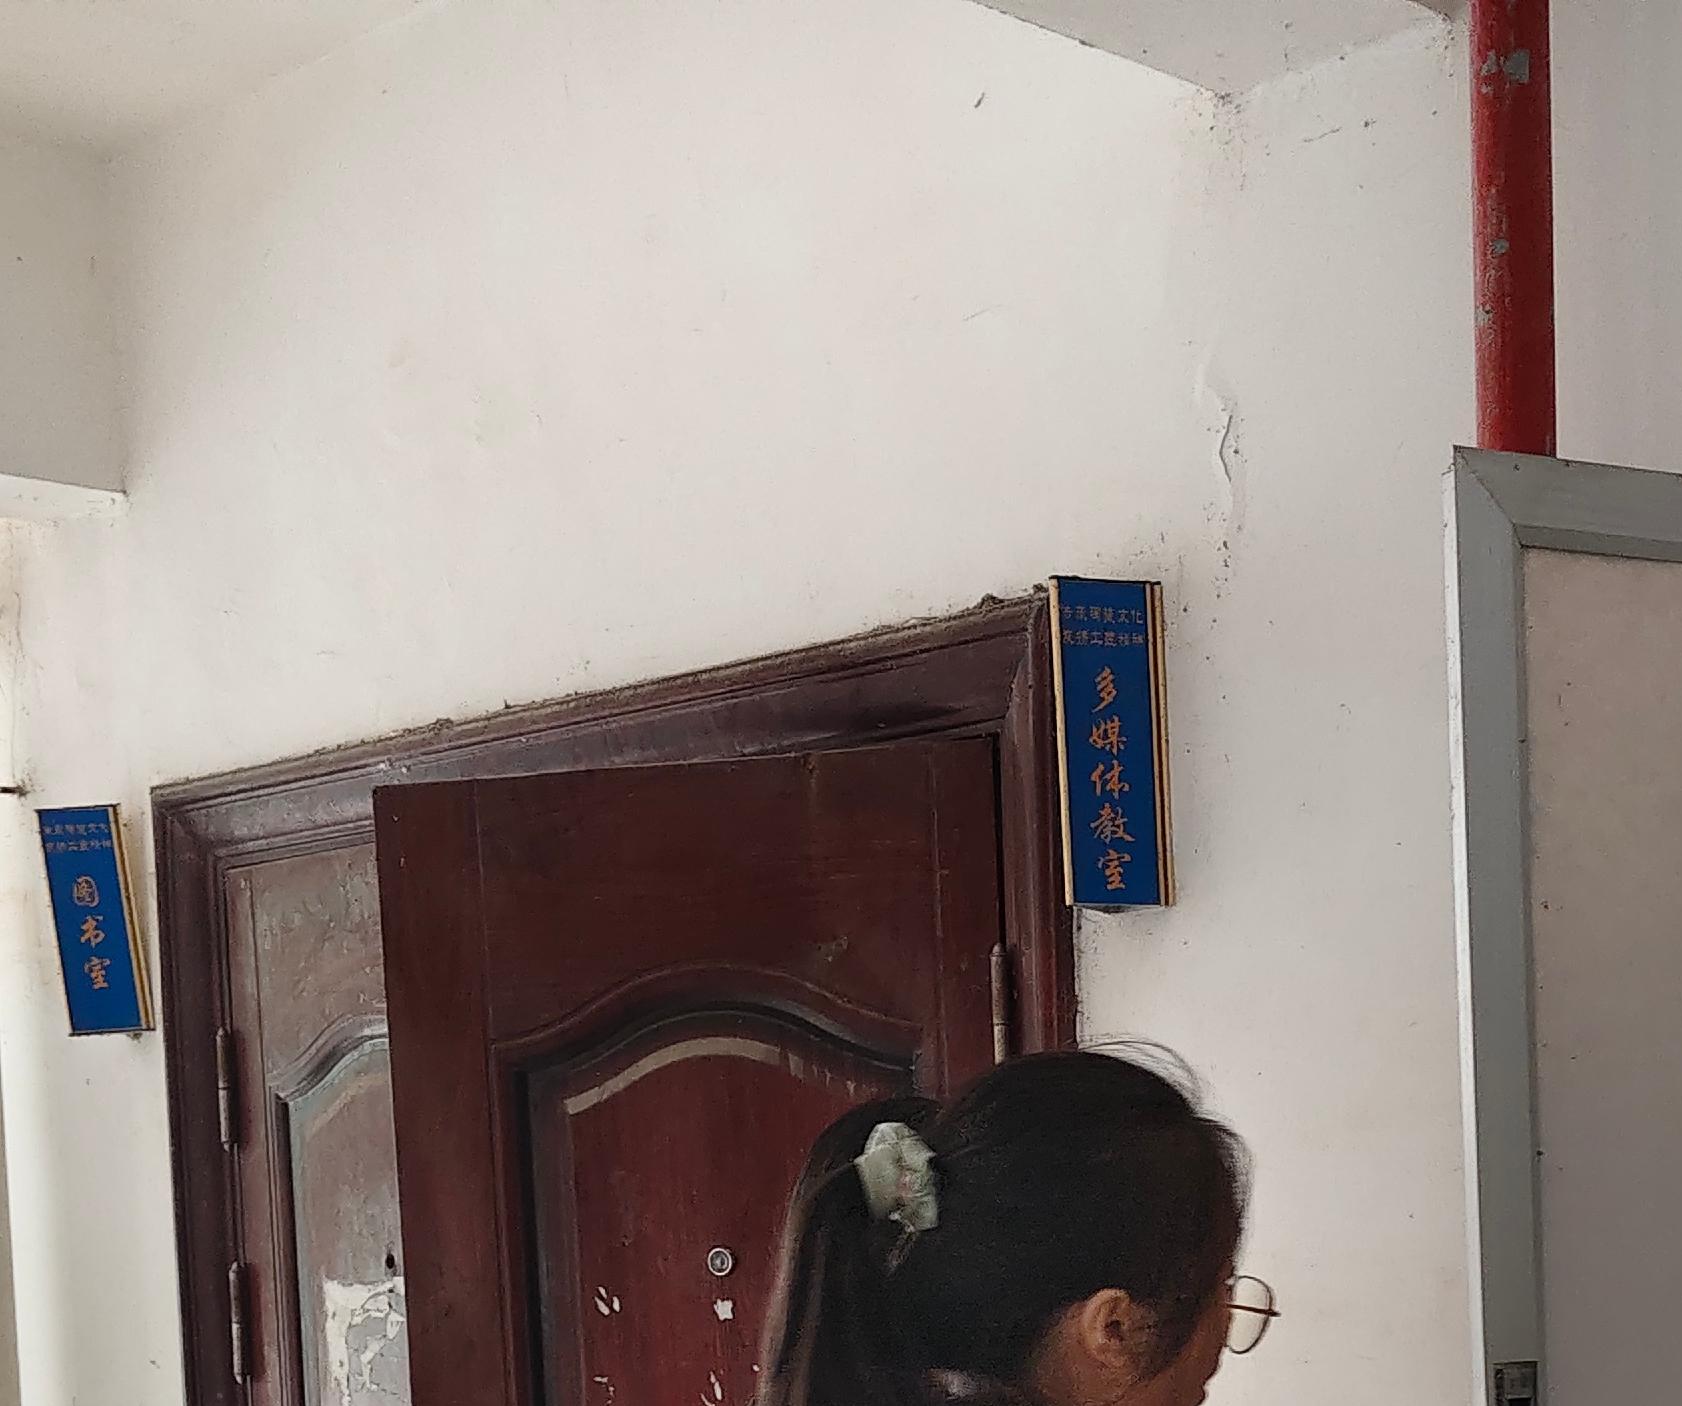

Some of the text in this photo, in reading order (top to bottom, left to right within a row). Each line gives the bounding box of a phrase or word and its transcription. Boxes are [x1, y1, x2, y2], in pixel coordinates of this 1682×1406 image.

[1088, 666, 1136, 891] 多媒体教室
[71, 875, 111, 990] 图书室
